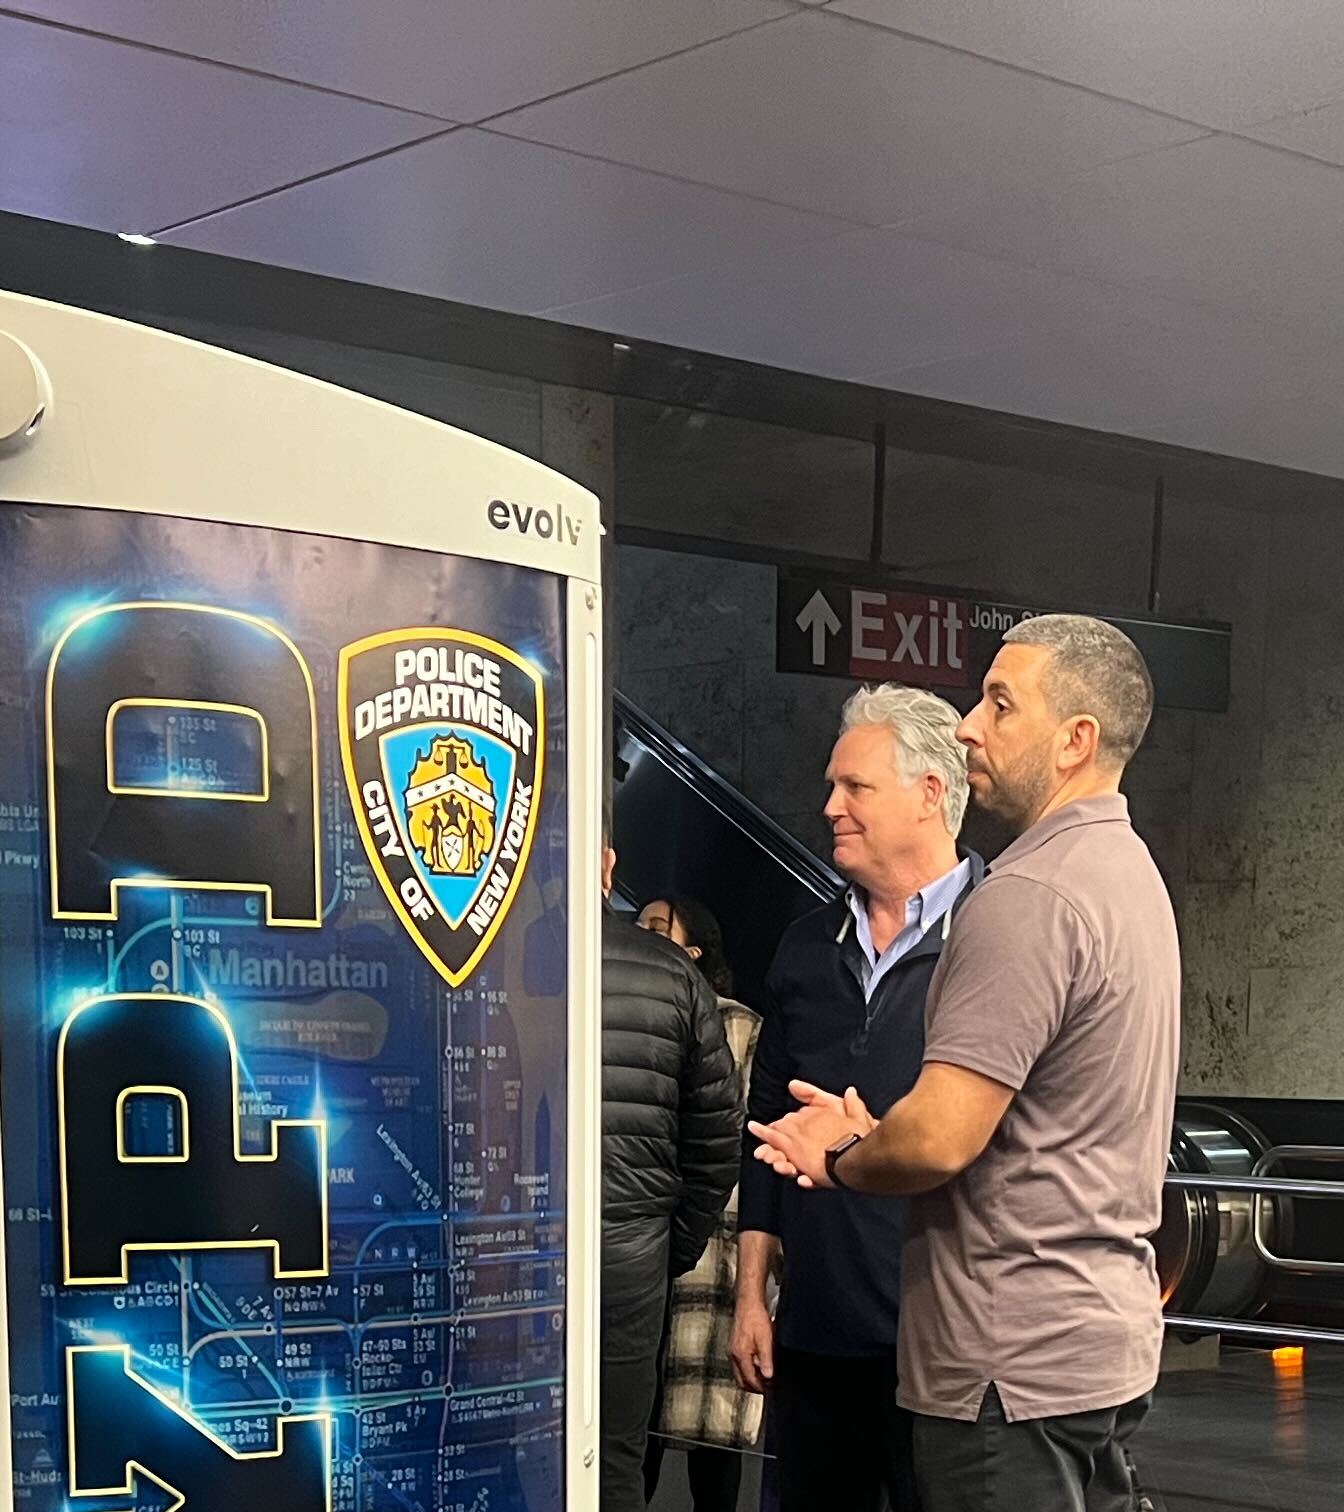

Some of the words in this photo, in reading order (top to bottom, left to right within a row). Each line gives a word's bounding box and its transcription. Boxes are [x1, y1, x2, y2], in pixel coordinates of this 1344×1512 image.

[487, 499, 583, 547] evolv
[969, 605, 1014, 631] John
[851, 590, 963, 669] Exit
[394, 647, 502, 698] POLICE
[354, 683, 534, 756] DEPARTMENT
[362, 779, 406, 858] CITY
[400, 876, 436, 922] OF
[466, 863, 511, 937] NEW
[499, 778, 534, 863] YORK
[209, 949, 388, 988] Manhattan
[454, 1185, 484, 1199] College
[455, 1233, 493, 1246] Lexington
[144, 1281, 179, 1293] Circle
[284, 1288, 295, 1299] 57
[325, 1285, 339, 1296] Av
[360, 1285, 371, 1296] 57
[374, 1284, 384, 1296] St
[285, 1344, 298, 1355] 49
[362, 1423, 393, 1437] Bryant
[395, 1422, 407, 1433] Pk
